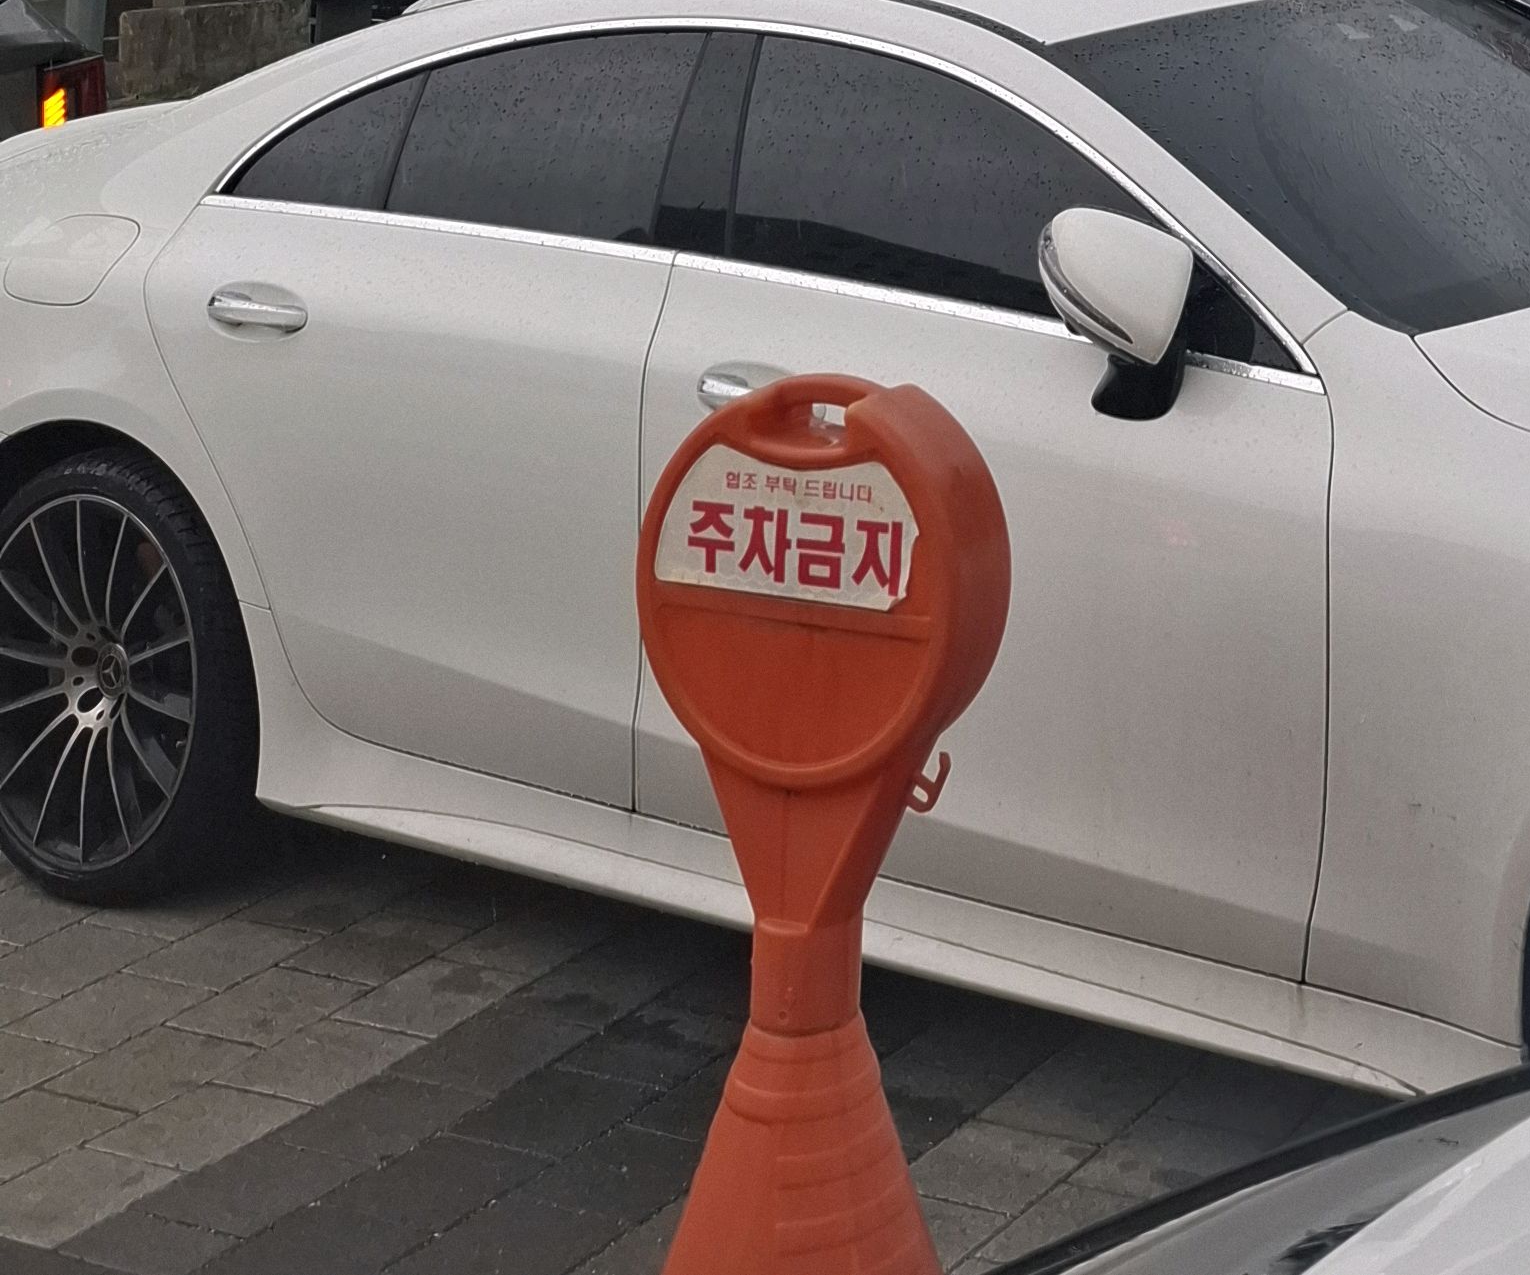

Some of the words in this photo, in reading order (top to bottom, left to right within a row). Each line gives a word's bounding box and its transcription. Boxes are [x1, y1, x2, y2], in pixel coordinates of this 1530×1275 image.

[765, 474, 798, 496] 부탁
[803, 479, 873, 504] 드립니다
[687, 500, 904, 598] 주차금지
